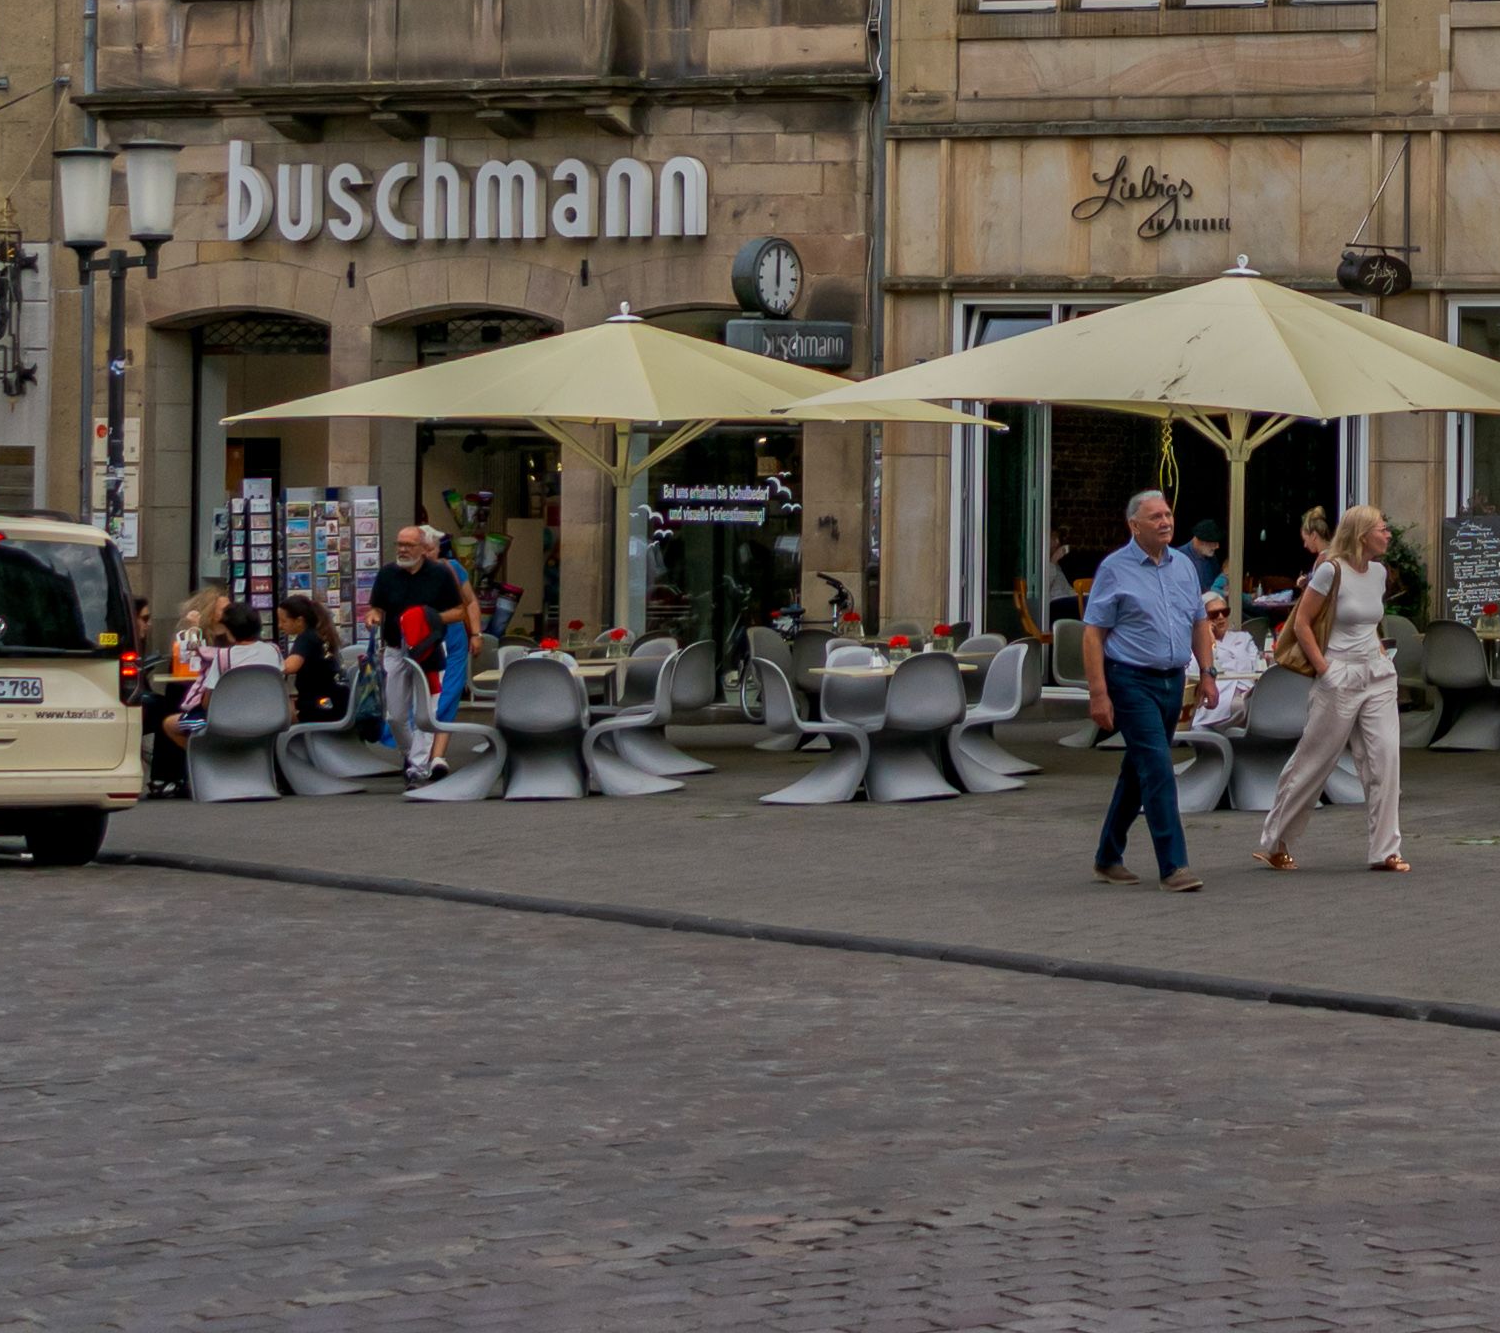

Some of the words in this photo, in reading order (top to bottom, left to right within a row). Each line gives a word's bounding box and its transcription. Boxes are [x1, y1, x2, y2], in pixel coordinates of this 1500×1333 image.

[228, 136, 707, 241] buschmann
[1071, 155, 1194, 239] Liebigs
[9, 681, 41, 697] 786
